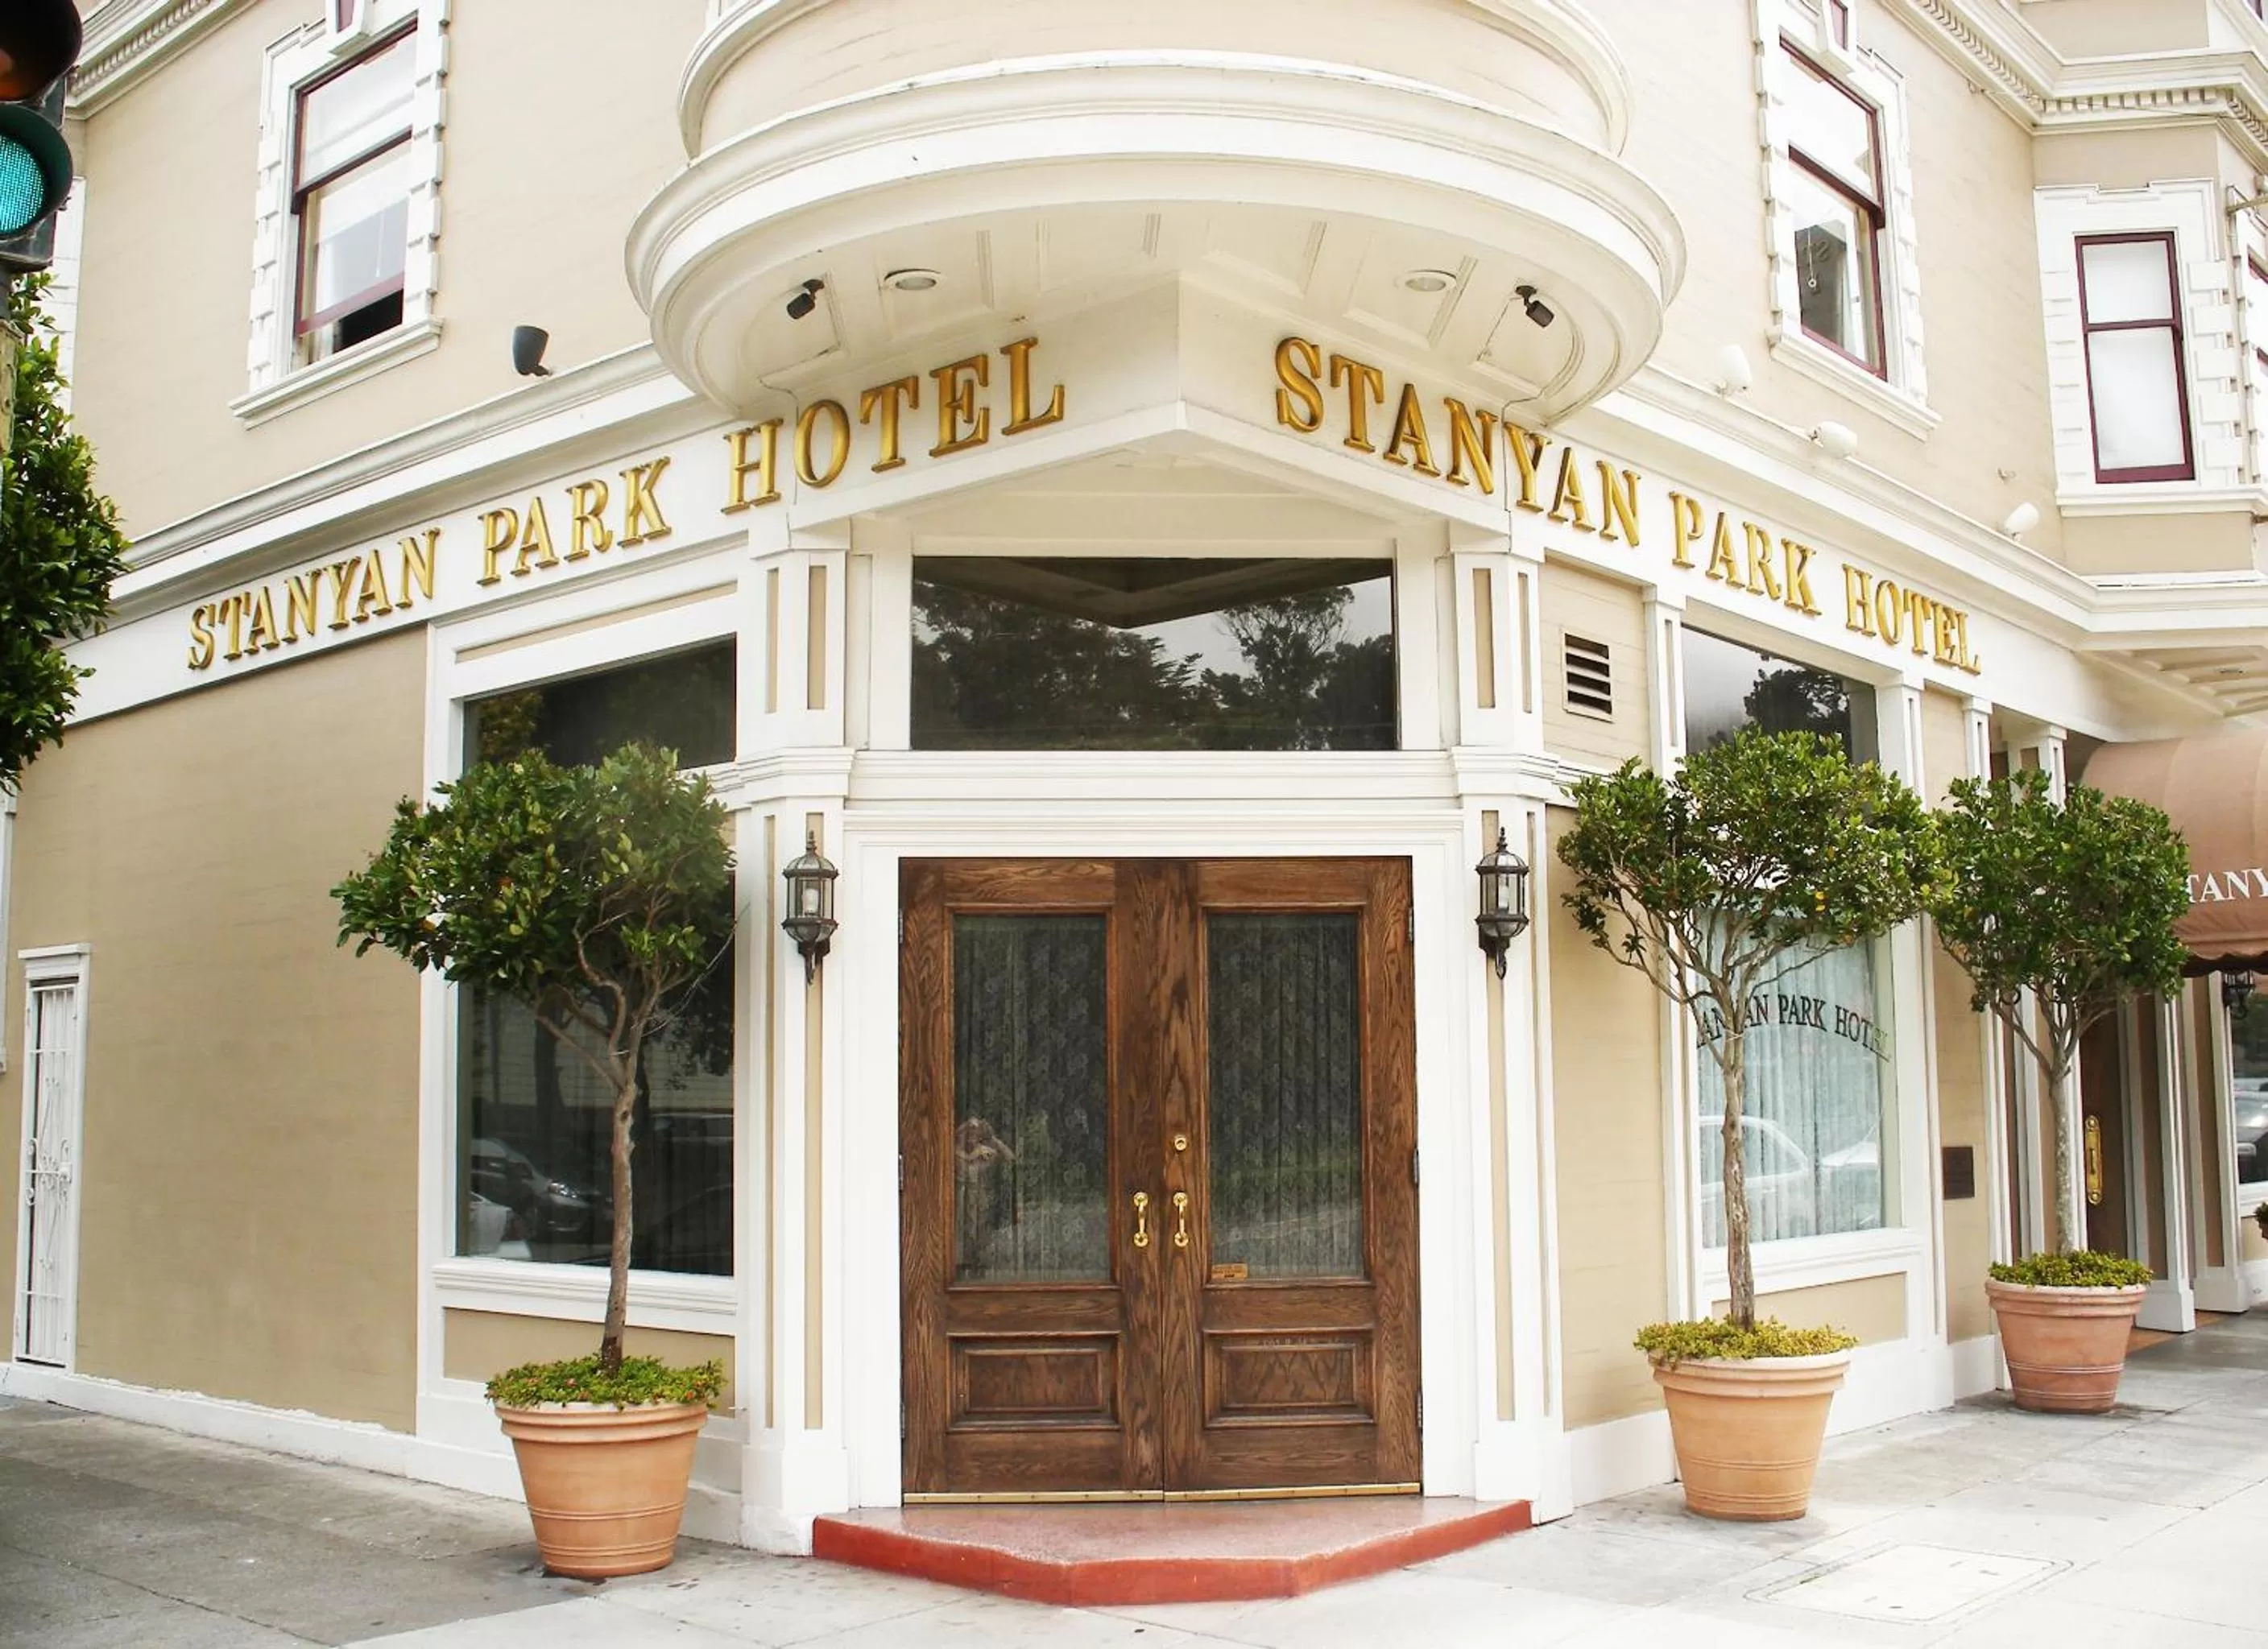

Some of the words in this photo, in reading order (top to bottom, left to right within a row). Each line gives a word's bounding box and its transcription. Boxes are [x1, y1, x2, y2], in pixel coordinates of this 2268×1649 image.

[188, 527, 441, 669] STANYAN
[477, 456, 672, 585] PARK
[722, 337, 1065, 513] HOTEL
[1275, 337, 1641, 548] STANYAN
[1670, 490, 1821, 616] PARK
[1843, 563, 1981, 675] HOTEL
[1778, 994, 1827, 1031] PARK
